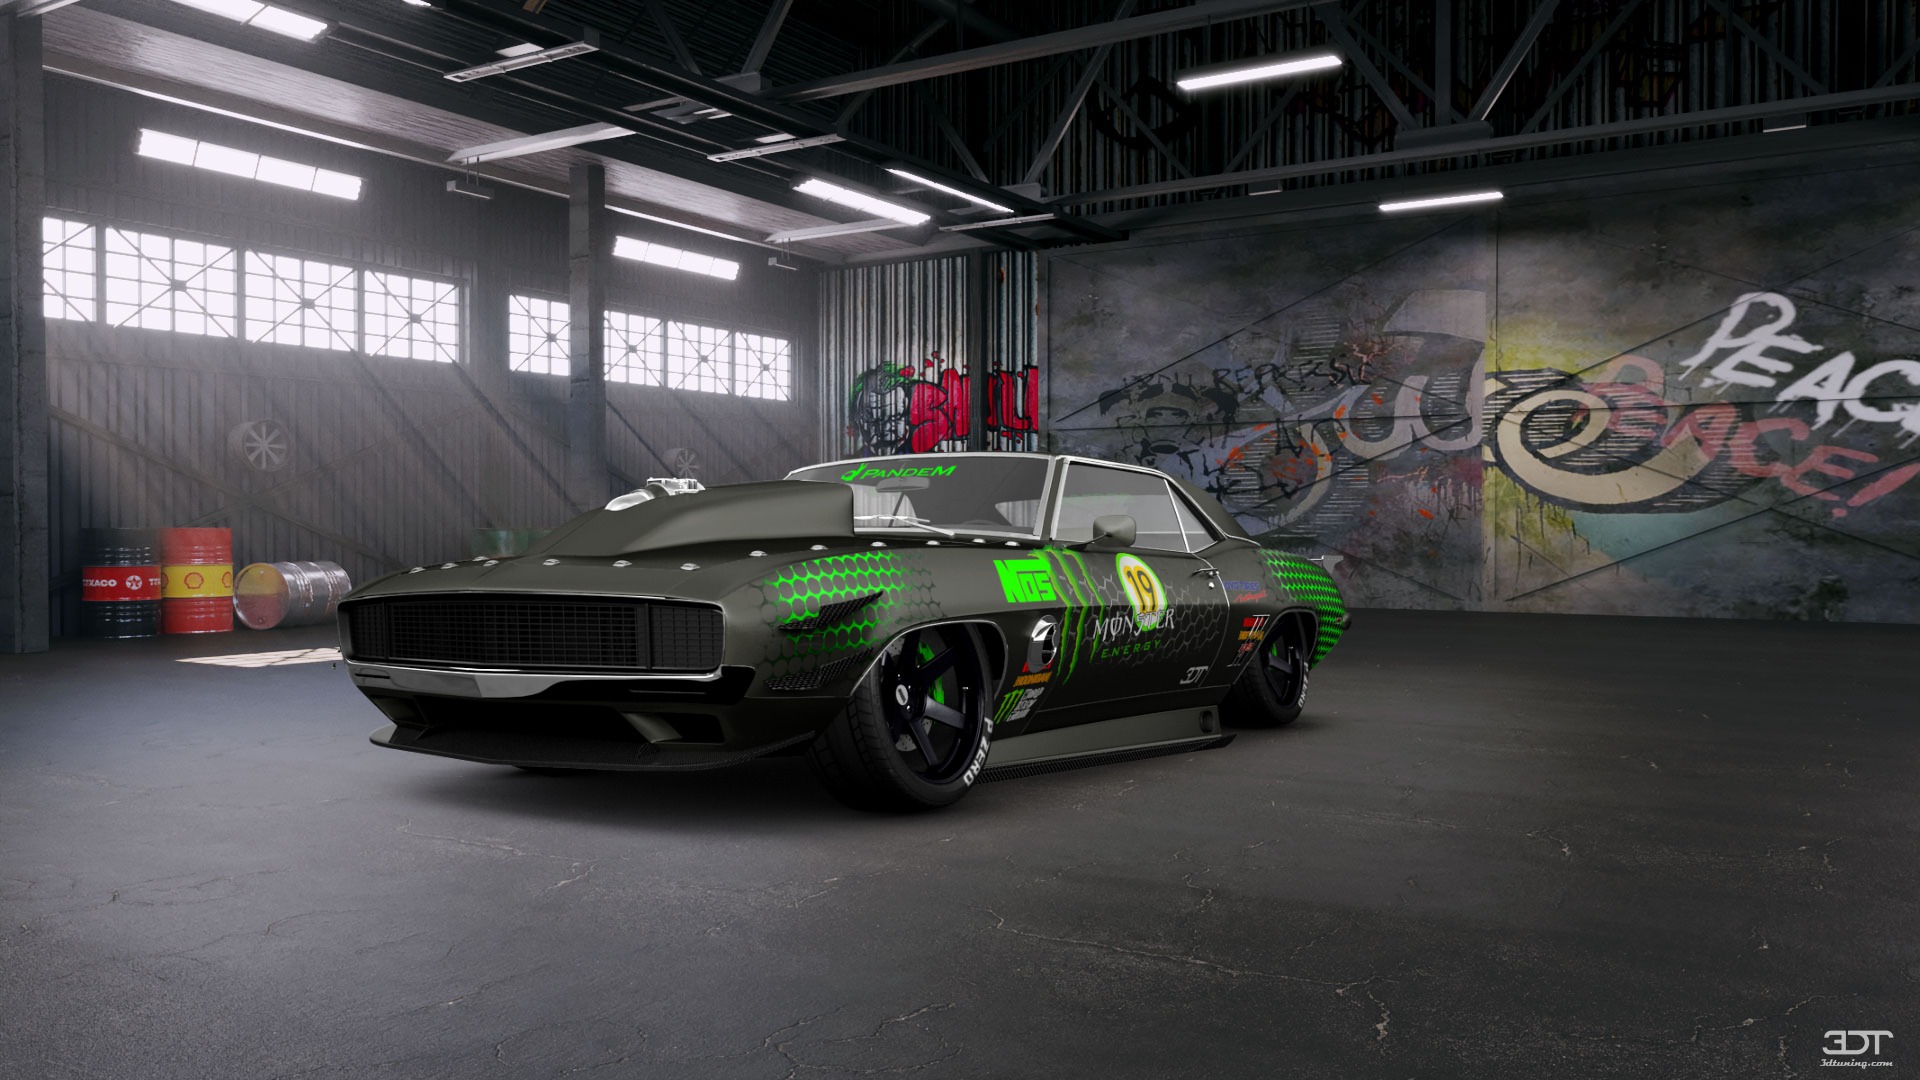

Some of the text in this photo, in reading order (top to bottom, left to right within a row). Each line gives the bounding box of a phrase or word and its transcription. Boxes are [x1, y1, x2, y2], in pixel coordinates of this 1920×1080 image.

[1126, 570, 1157, 612] 19
[1101, 640, 1160, 659] ENERGY
[963, 736, 989, 787] ZERO
